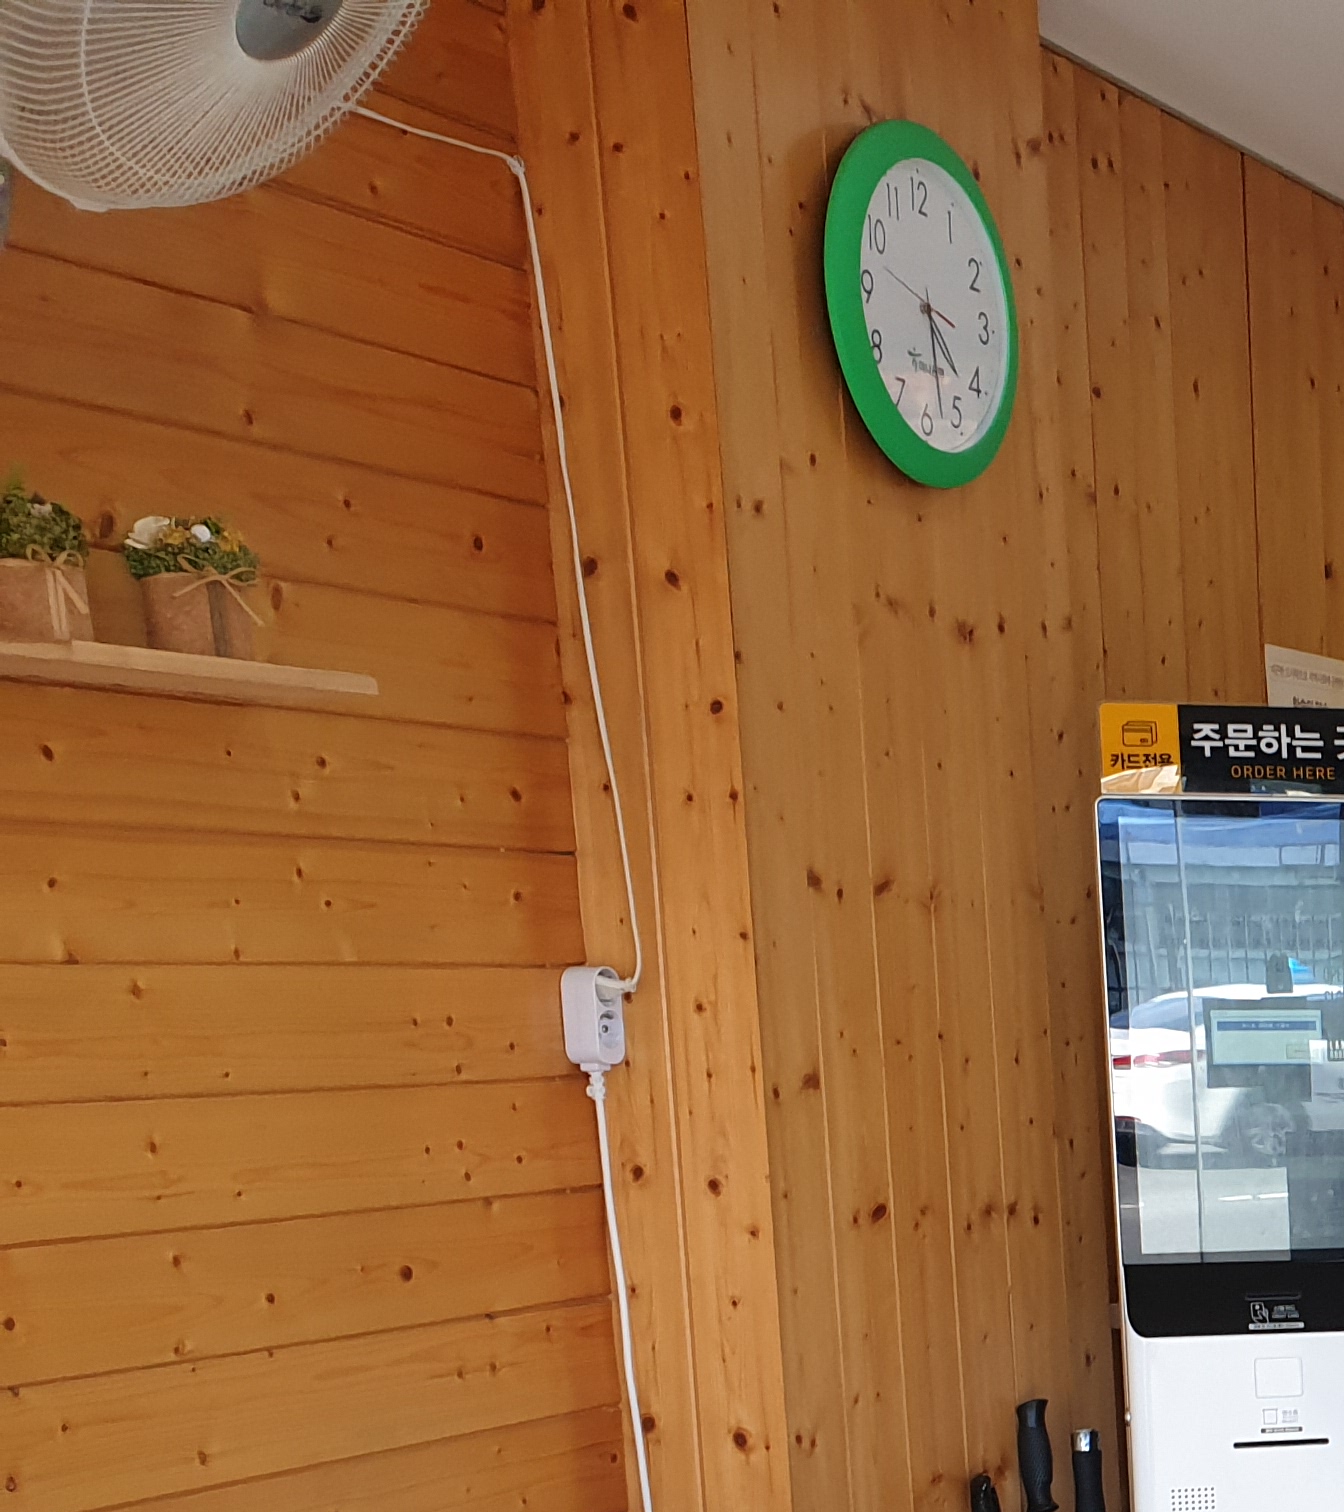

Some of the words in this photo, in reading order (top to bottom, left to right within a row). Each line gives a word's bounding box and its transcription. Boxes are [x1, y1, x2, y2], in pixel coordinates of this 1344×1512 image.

[887, 183, 899, 221] 11
[911, 176, 928, 217] 12
[868, 214, 885, 254] 10
[948, 209, 952, 244] 1
[861, 269, 873, 303] 9
[968, 257, 980, 292] 2
[978, 312, 989, 345] 3
[872, 330, 882, 364] 8
[895, 377, 905, 405] 7
[969, 366, 981, 398] 4
[921, 403, 933, 436] 6
[951, 396, 962, 428] 5
[1191, 723, 1323, 759] 주문하는
[1231, 765, 1286, 779] ORDER
[1293, 766, 1336, 780] HERE
